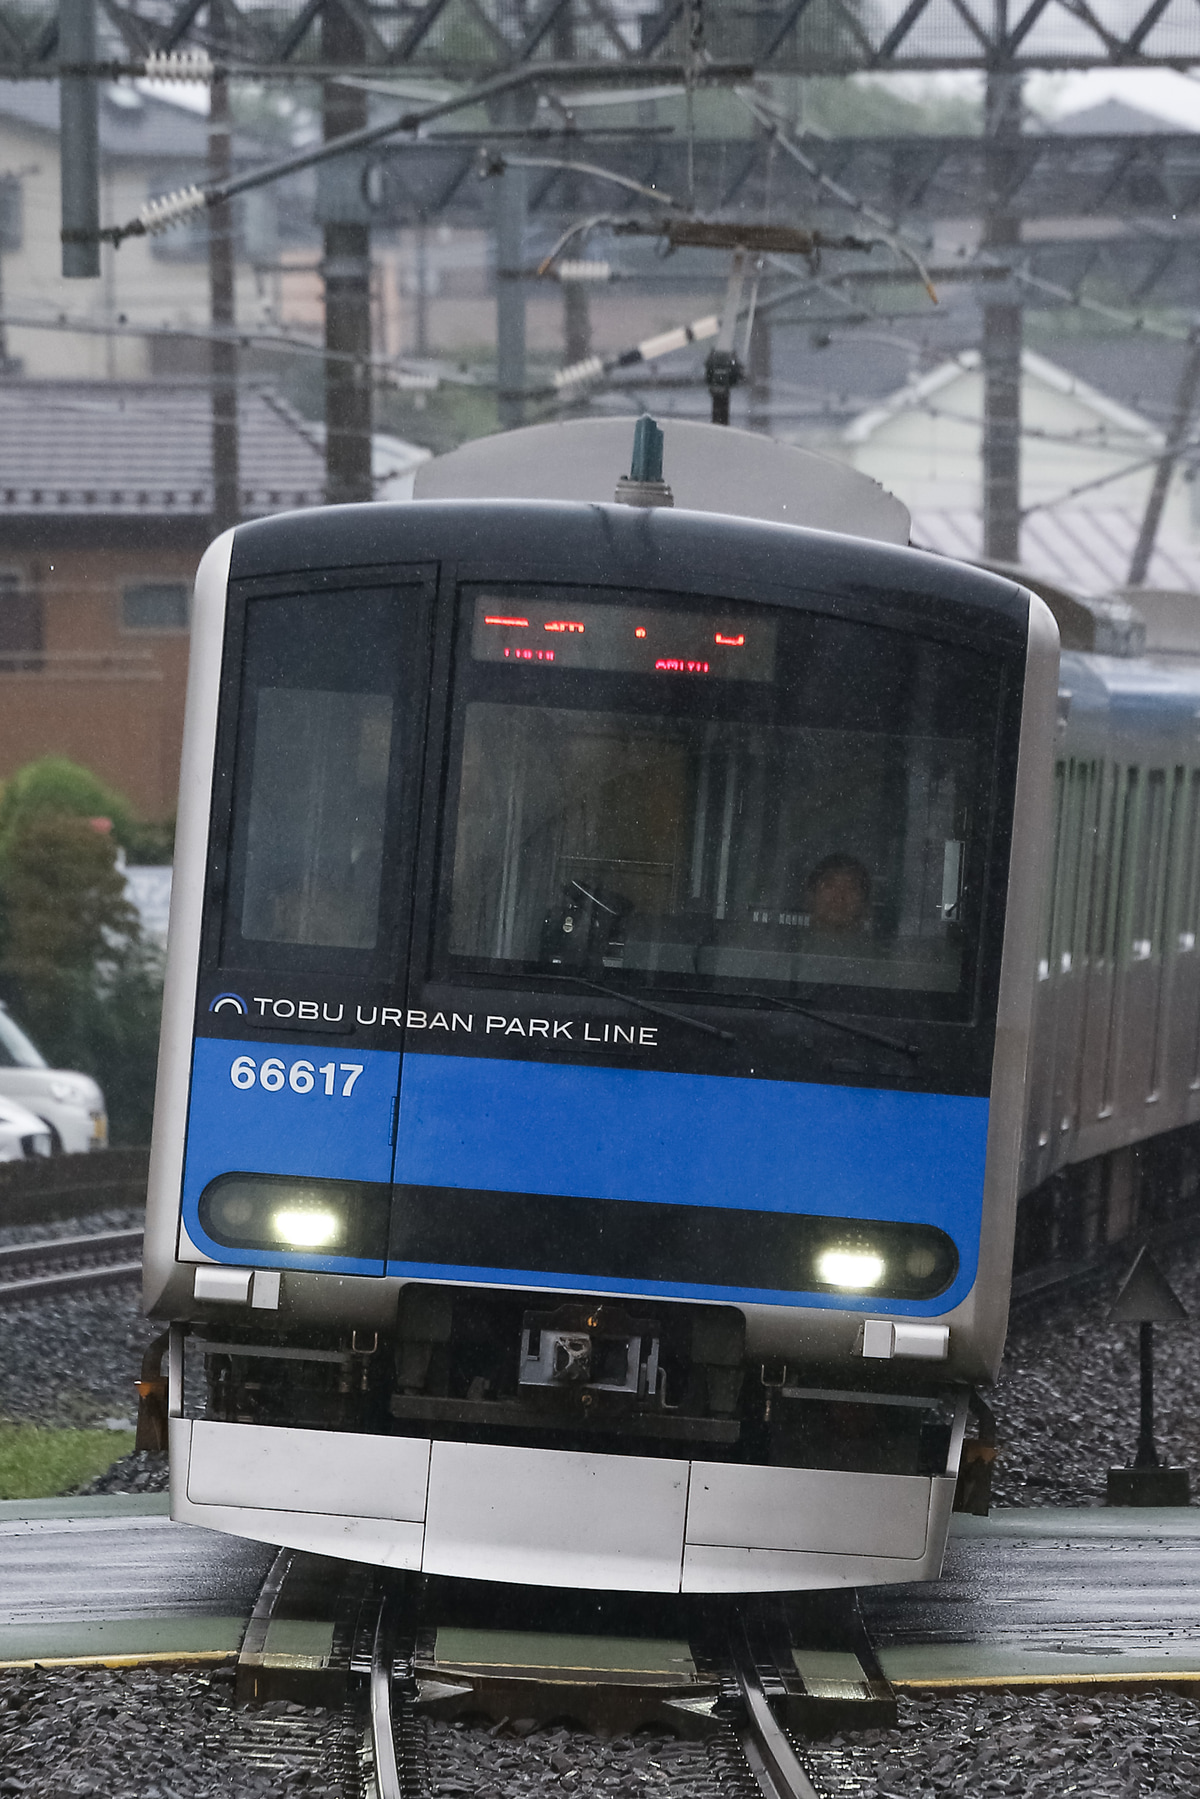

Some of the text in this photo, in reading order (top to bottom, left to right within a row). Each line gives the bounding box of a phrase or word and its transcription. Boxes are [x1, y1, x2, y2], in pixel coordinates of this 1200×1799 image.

[253, 997, 658, 1046] TOBU URBAN PARK LINE
[230, 1055, 364, 1097] 66617
